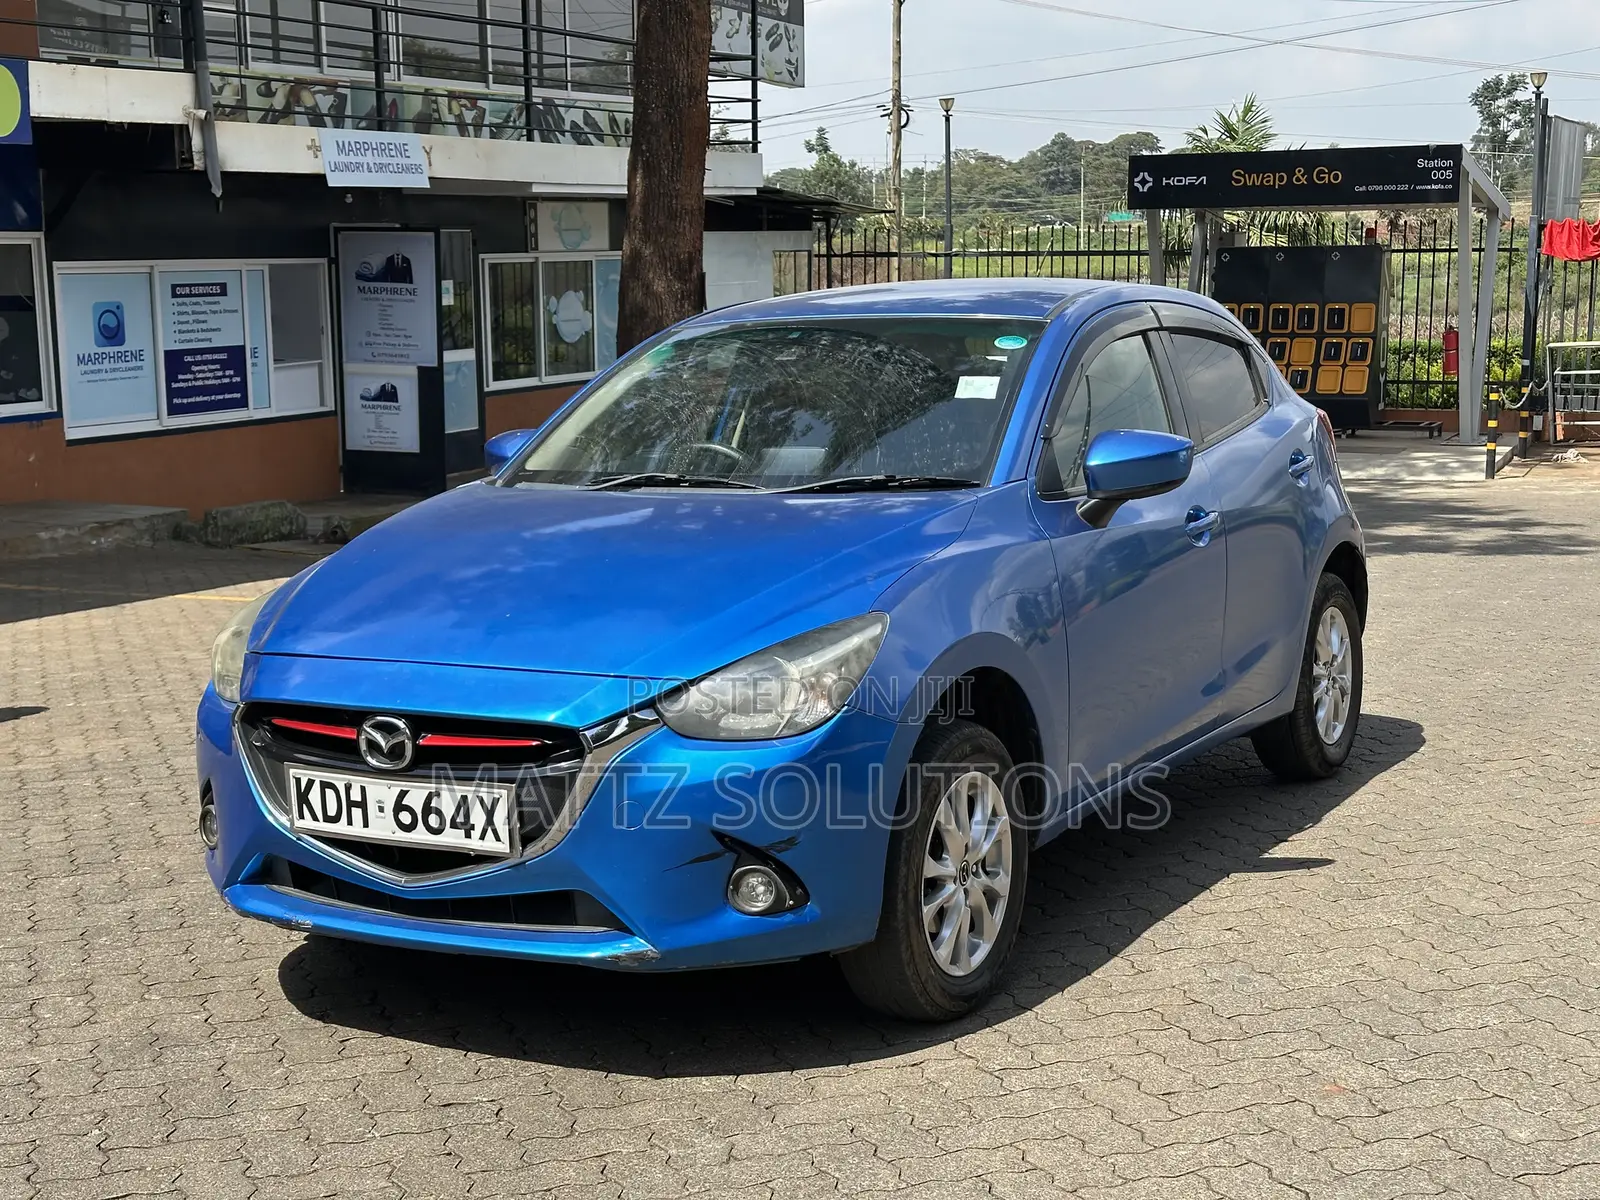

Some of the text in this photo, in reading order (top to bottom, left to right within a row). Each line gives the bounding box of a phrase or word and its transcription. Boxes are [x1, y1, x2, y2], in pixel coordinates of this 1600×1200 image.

[335, 140, 411, 159] MARPHRENE
[328, 161, 424, 175] LAUNDRY & DRYCLEANERS
[1416, 158, 1454, 168] Station
[1162, 175, 1207, 186] KOFA
[1231, 166, 1343, 189] Swap & Go
[1431, 170, 1453, 180] 005
[175, 285, 221, 294] OUR SERVICES
[357, 285, 418, 297] MARPHRENE
[76, 349, 145, 367] MARPHRENE
[361, 403, 402, 411] MARPHRENE
[294, 776, 503, 843] KDH 664X
